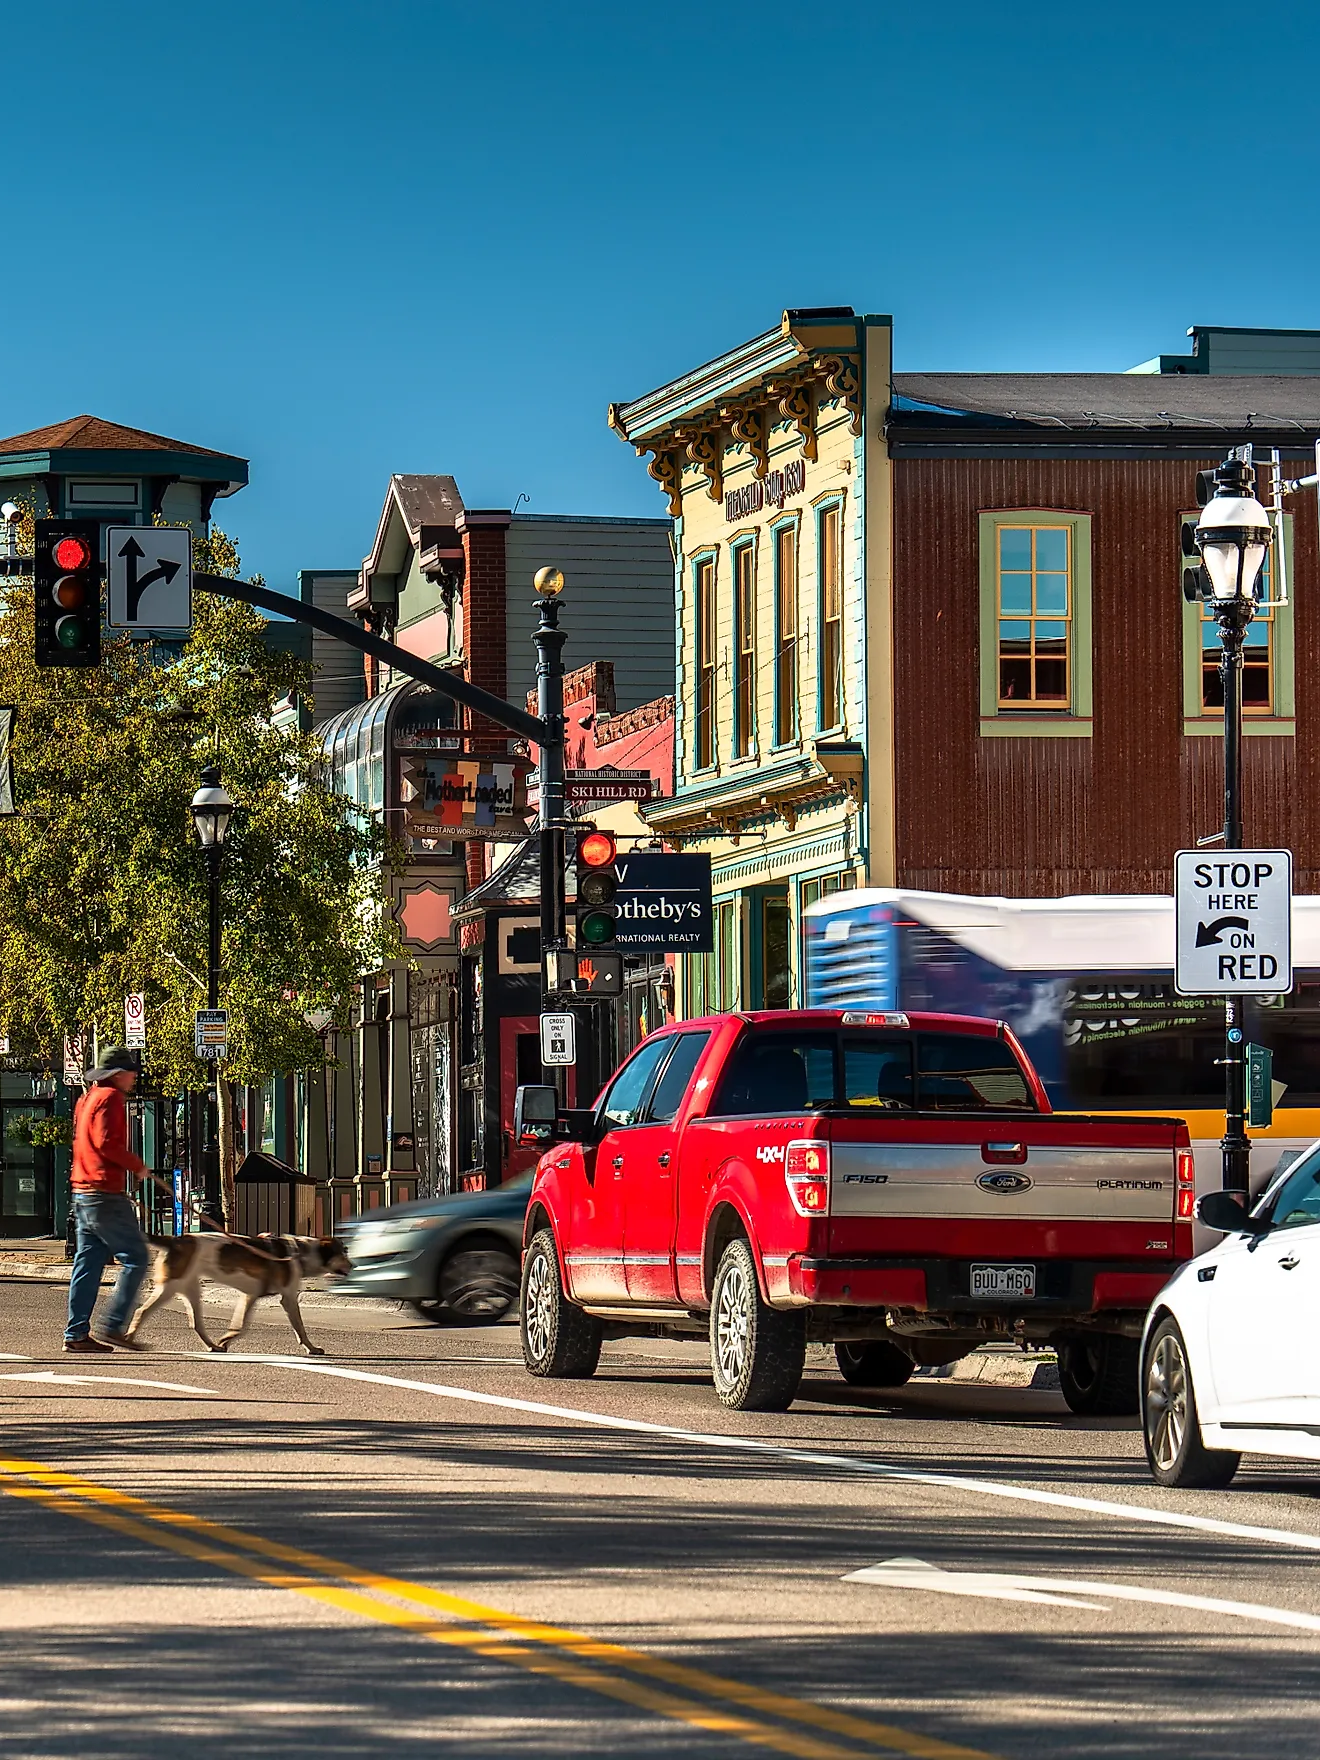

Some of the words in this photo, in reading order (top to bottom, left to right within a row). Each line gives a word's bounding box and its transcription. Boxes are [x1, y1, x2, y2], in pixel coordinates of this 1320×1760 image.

[574, 770, 598, 778] NATIONAL
[598, 770, 620, 778] HISTORIC
[620, 770, 642, 778] DISTRICT
[571, 786, 594, 798] SKI
[595, 786, 626, 798] HILL
[628, 787, 647, 798] RD
[413, 824, 425, 833] THE
[426, 825, 441, 833] BEST
[441, 826, 456, 834] AND
[1194, 863, 1273, 888] STOP
[1208, 894, 1258, 910] HERE
[615, 897, 701, 923] otheby's
[616, 934, 666, 942] RNATIONAL
[668, 933, 701, 942] REALTY
[1230, 933, 1255, 948] ON
[1218, 954, 1278, 981] RED
[202, 1048, 219, 1057] 781
[756, 1145, 785, 1164] 4X4
[996, 1177, 1018, 1188] Ford
[1099, 1180, 1163, 1189] PLATINUM
